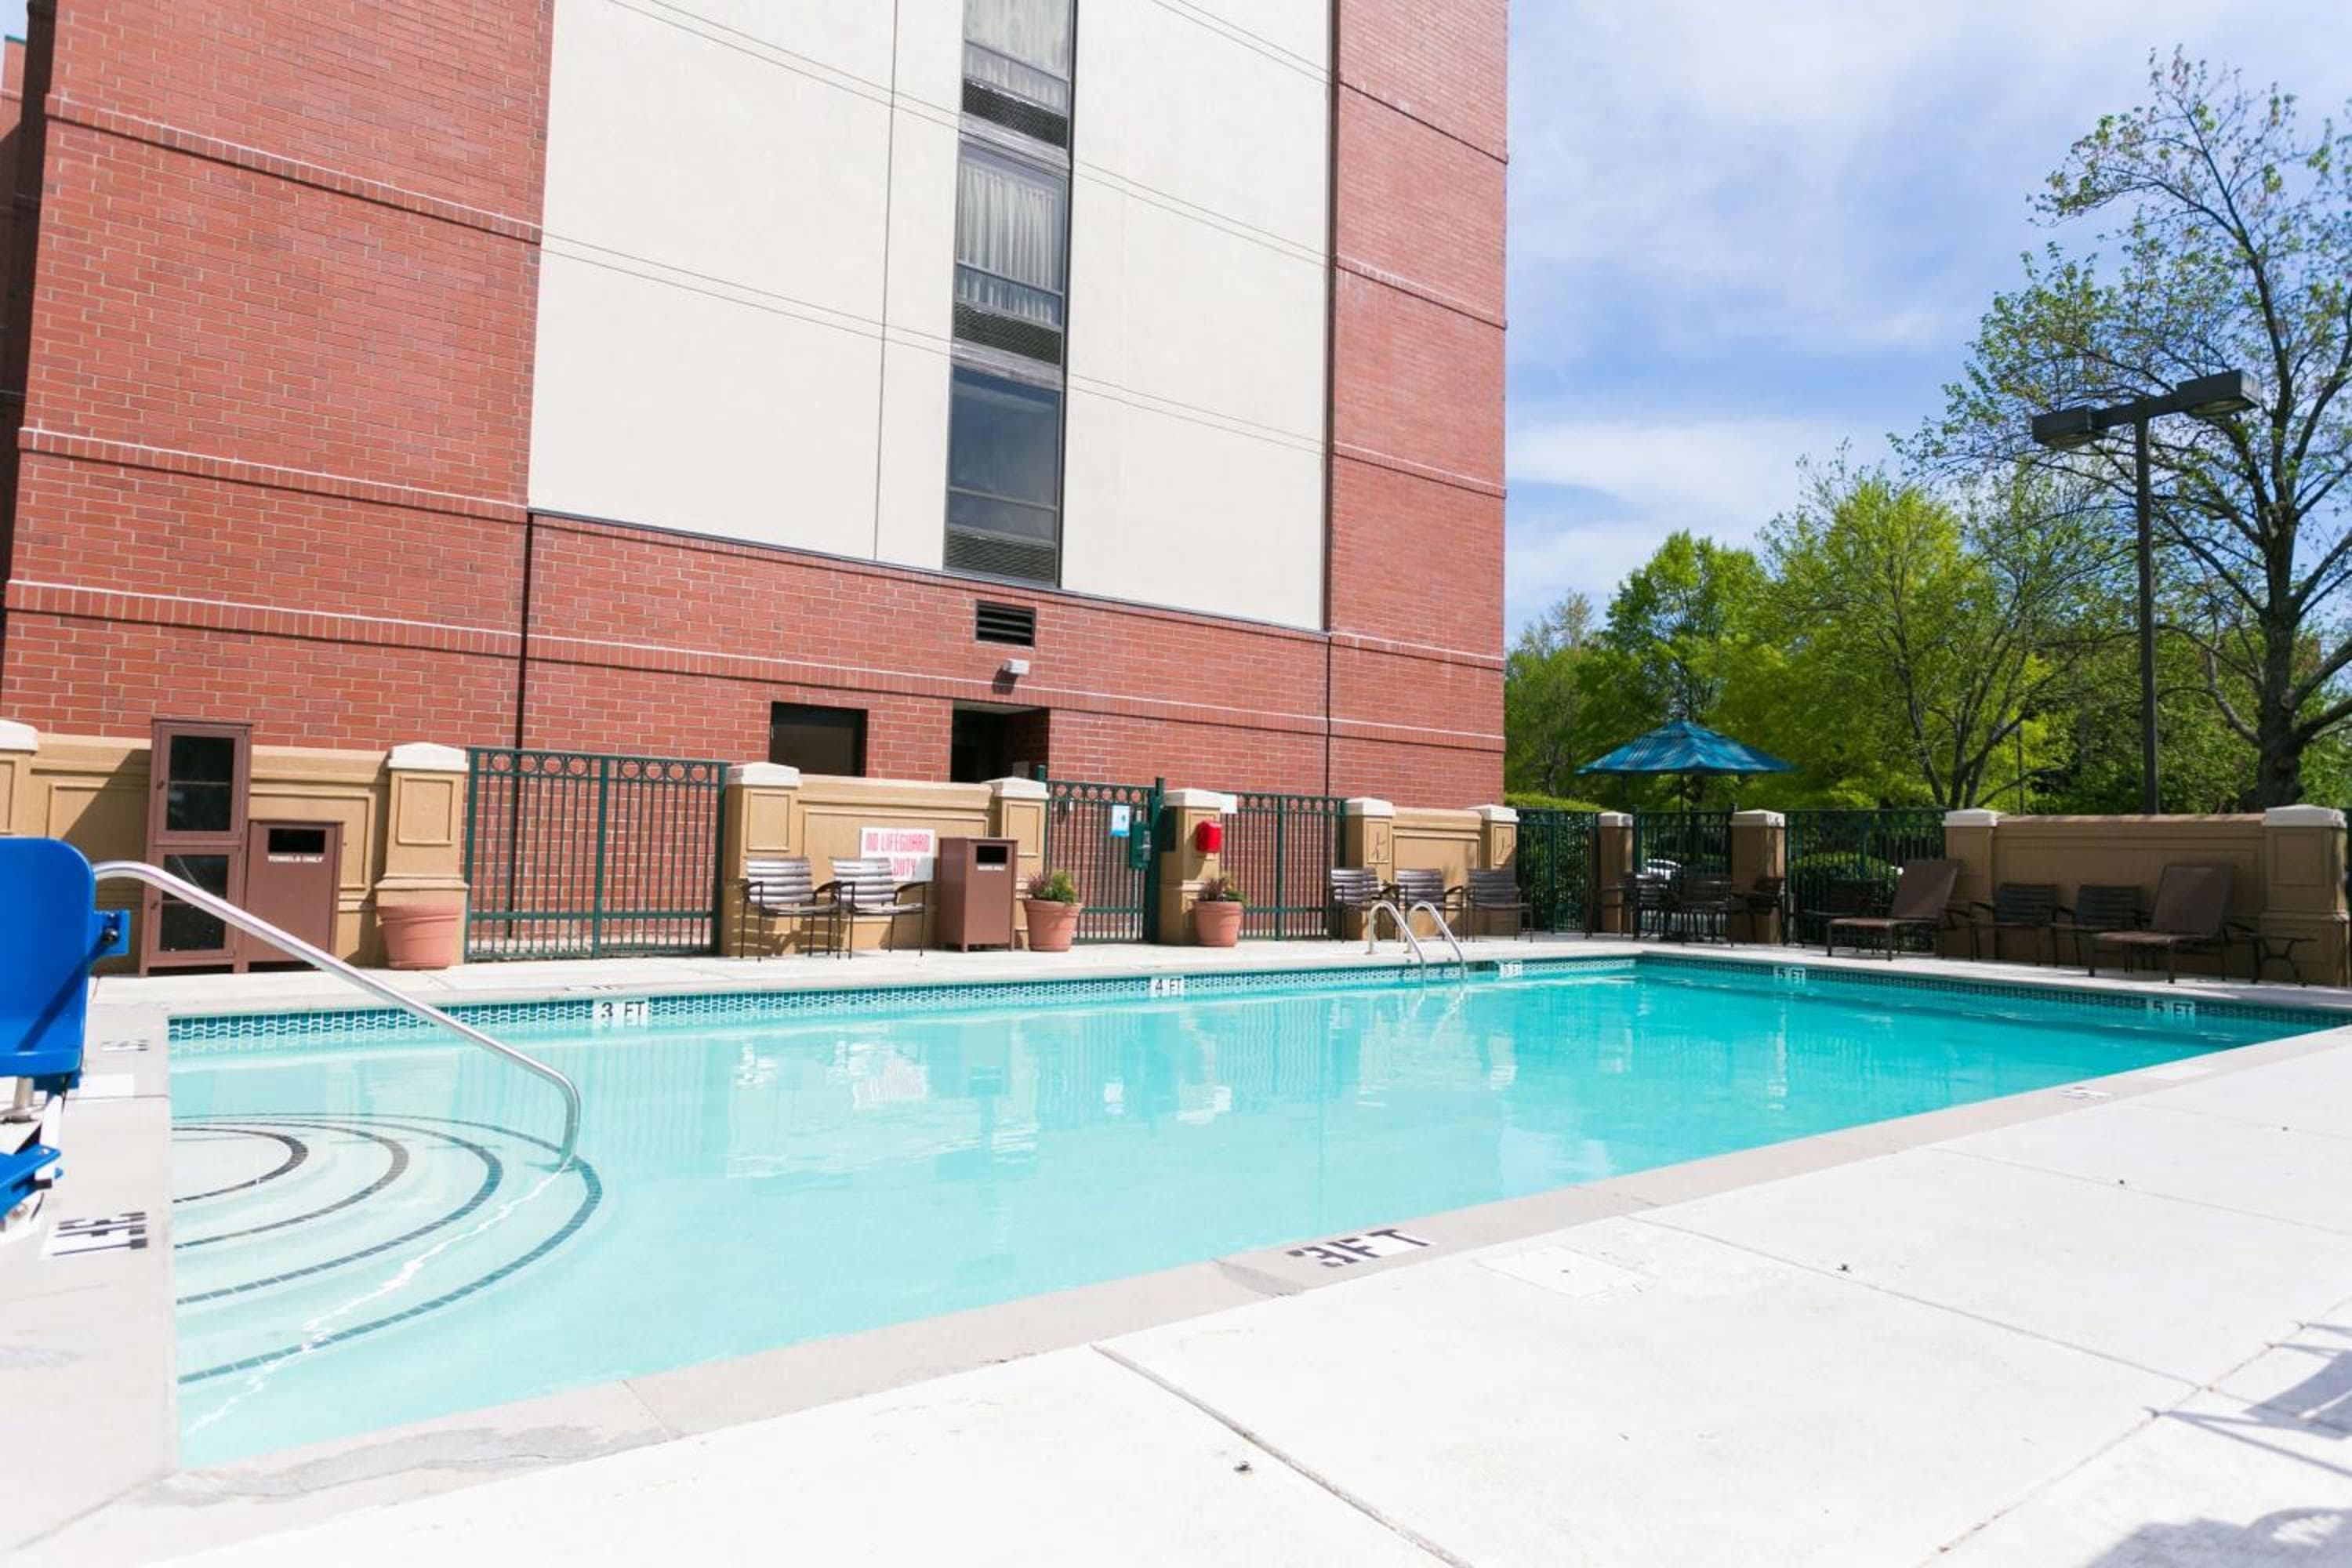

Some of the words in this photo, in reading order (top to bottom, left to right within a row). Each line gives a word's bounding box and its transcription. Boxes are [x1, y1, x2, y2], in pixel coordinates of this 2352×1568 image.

[865, 833, 879, 852] NO
[880, 833, 930, 853] LIFEGUARD
[1168, 978, 1181, 992] FT
[601, 1001, 613, 1017] 3
[624, 1000, 645, 1017] FT
[2172, 1003, 2194, 1017] FT
